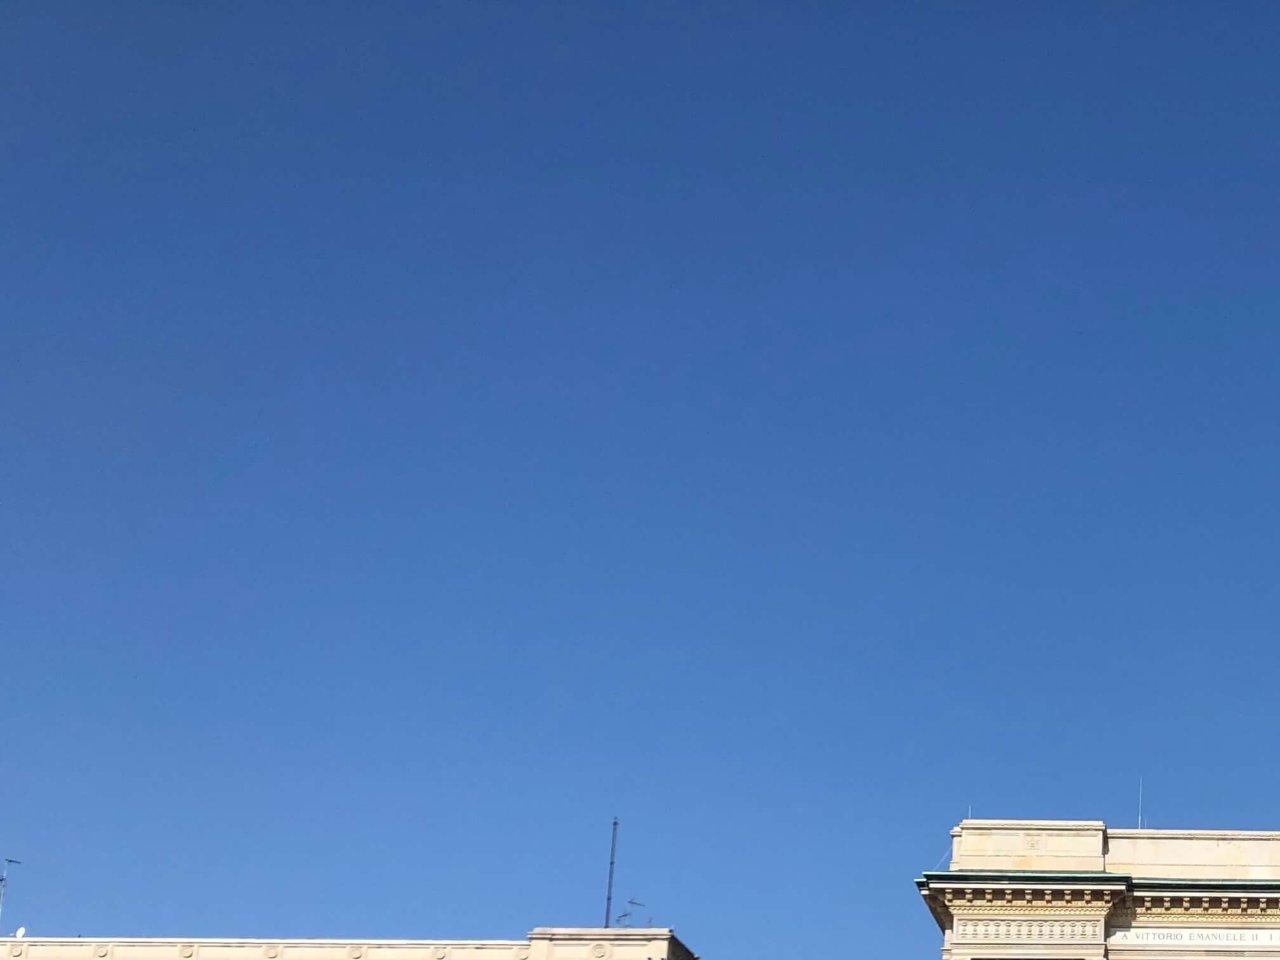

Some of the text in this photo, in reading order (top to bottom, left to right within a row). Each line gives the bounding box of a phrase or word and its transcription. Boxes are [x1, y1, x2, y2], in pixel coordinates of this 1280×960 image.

[1134, 932, 1183, 941] VITTORIO
[1188, 933, 1246, 942] EMANUELE
[1251, 933, 1259, 942] II
